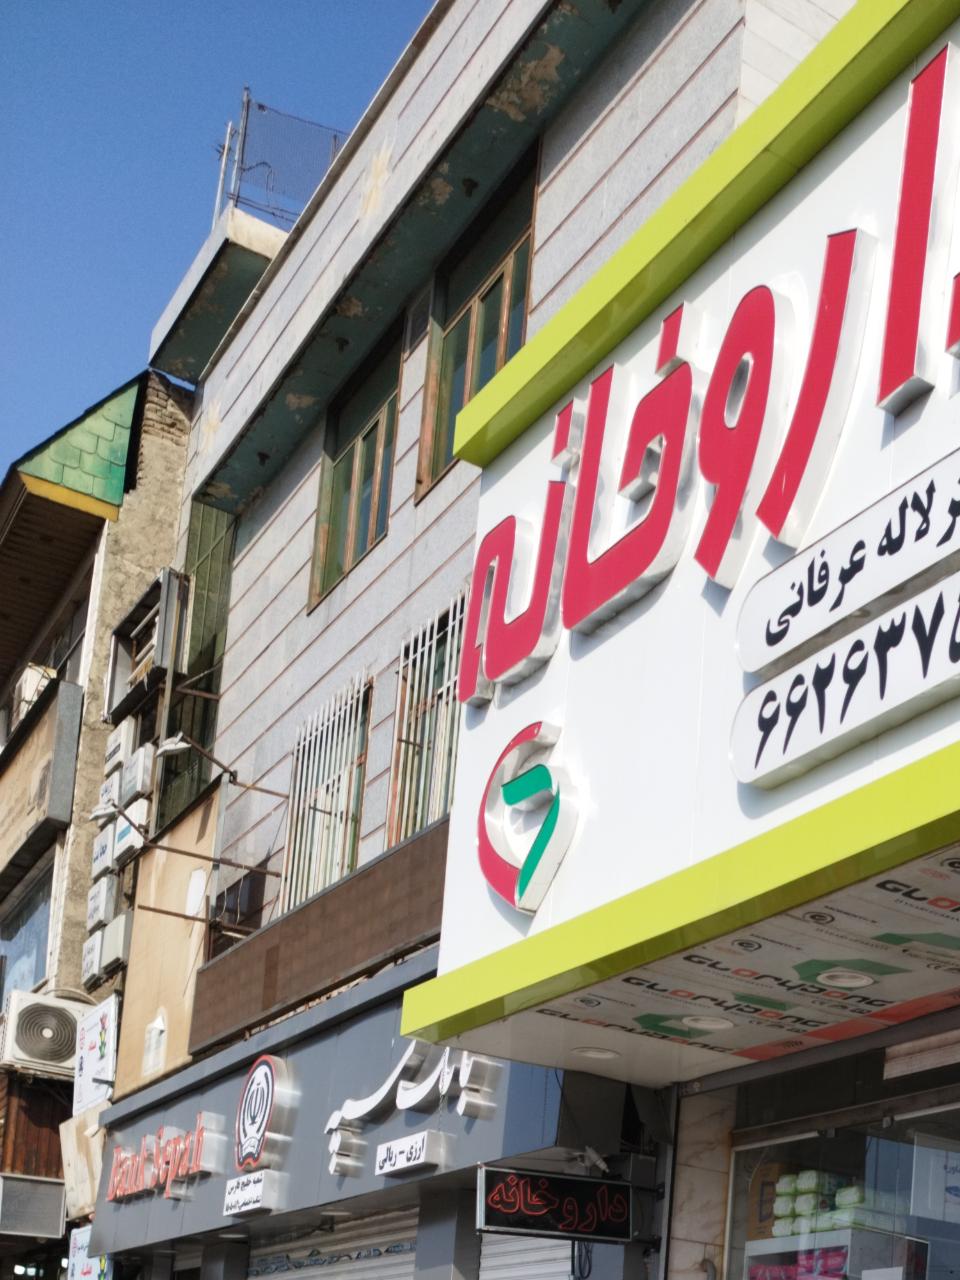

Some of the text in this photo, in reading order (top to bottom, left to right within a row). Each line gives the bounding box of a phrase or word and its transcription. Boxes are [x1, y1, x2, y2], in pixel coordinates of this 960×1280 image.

[877, 479, 936, 557] لاله
[765, 539, 866, 647] عرفانی
[107, 1111, 206, 1200] Bank Sepah
[406, 1136, 425, 1163] ارزی
[487, 1174, 628, 1232] داروخانه
